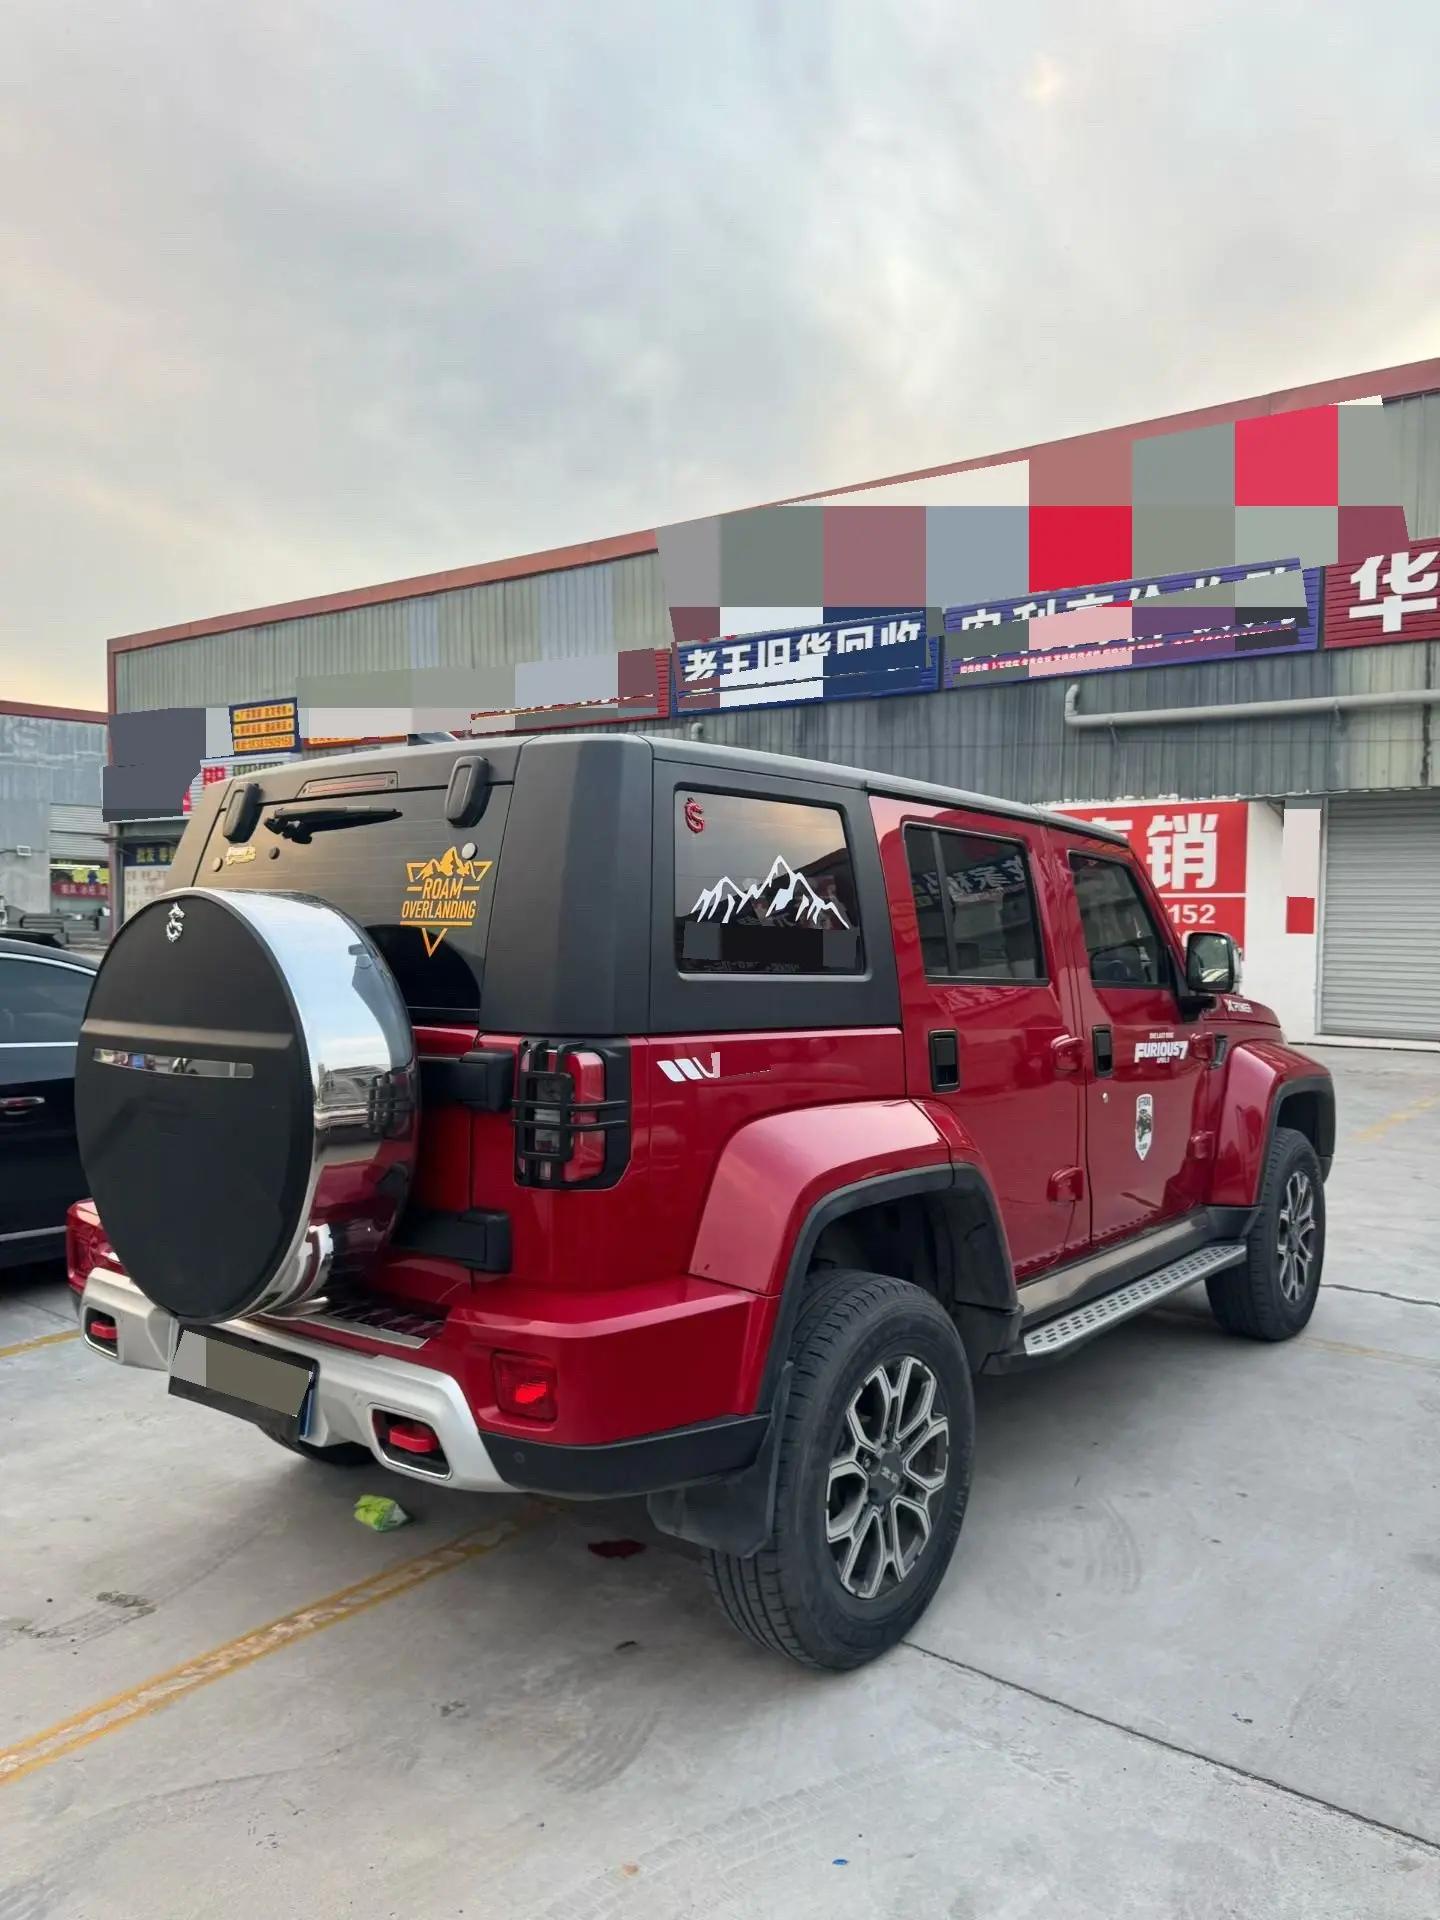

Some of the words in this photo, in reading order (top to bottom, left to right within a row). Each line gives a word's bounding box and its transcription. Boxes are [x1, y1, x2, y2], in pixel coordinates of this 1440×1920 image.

[1349, 551, 1439, 632] 华
[1090, 813, 1219, 889] 销
[422, 878, 463, 899] ROAM
[402, 901, 476, 918] OVERLANDING
[1165, 904, 1216, 924] 152
